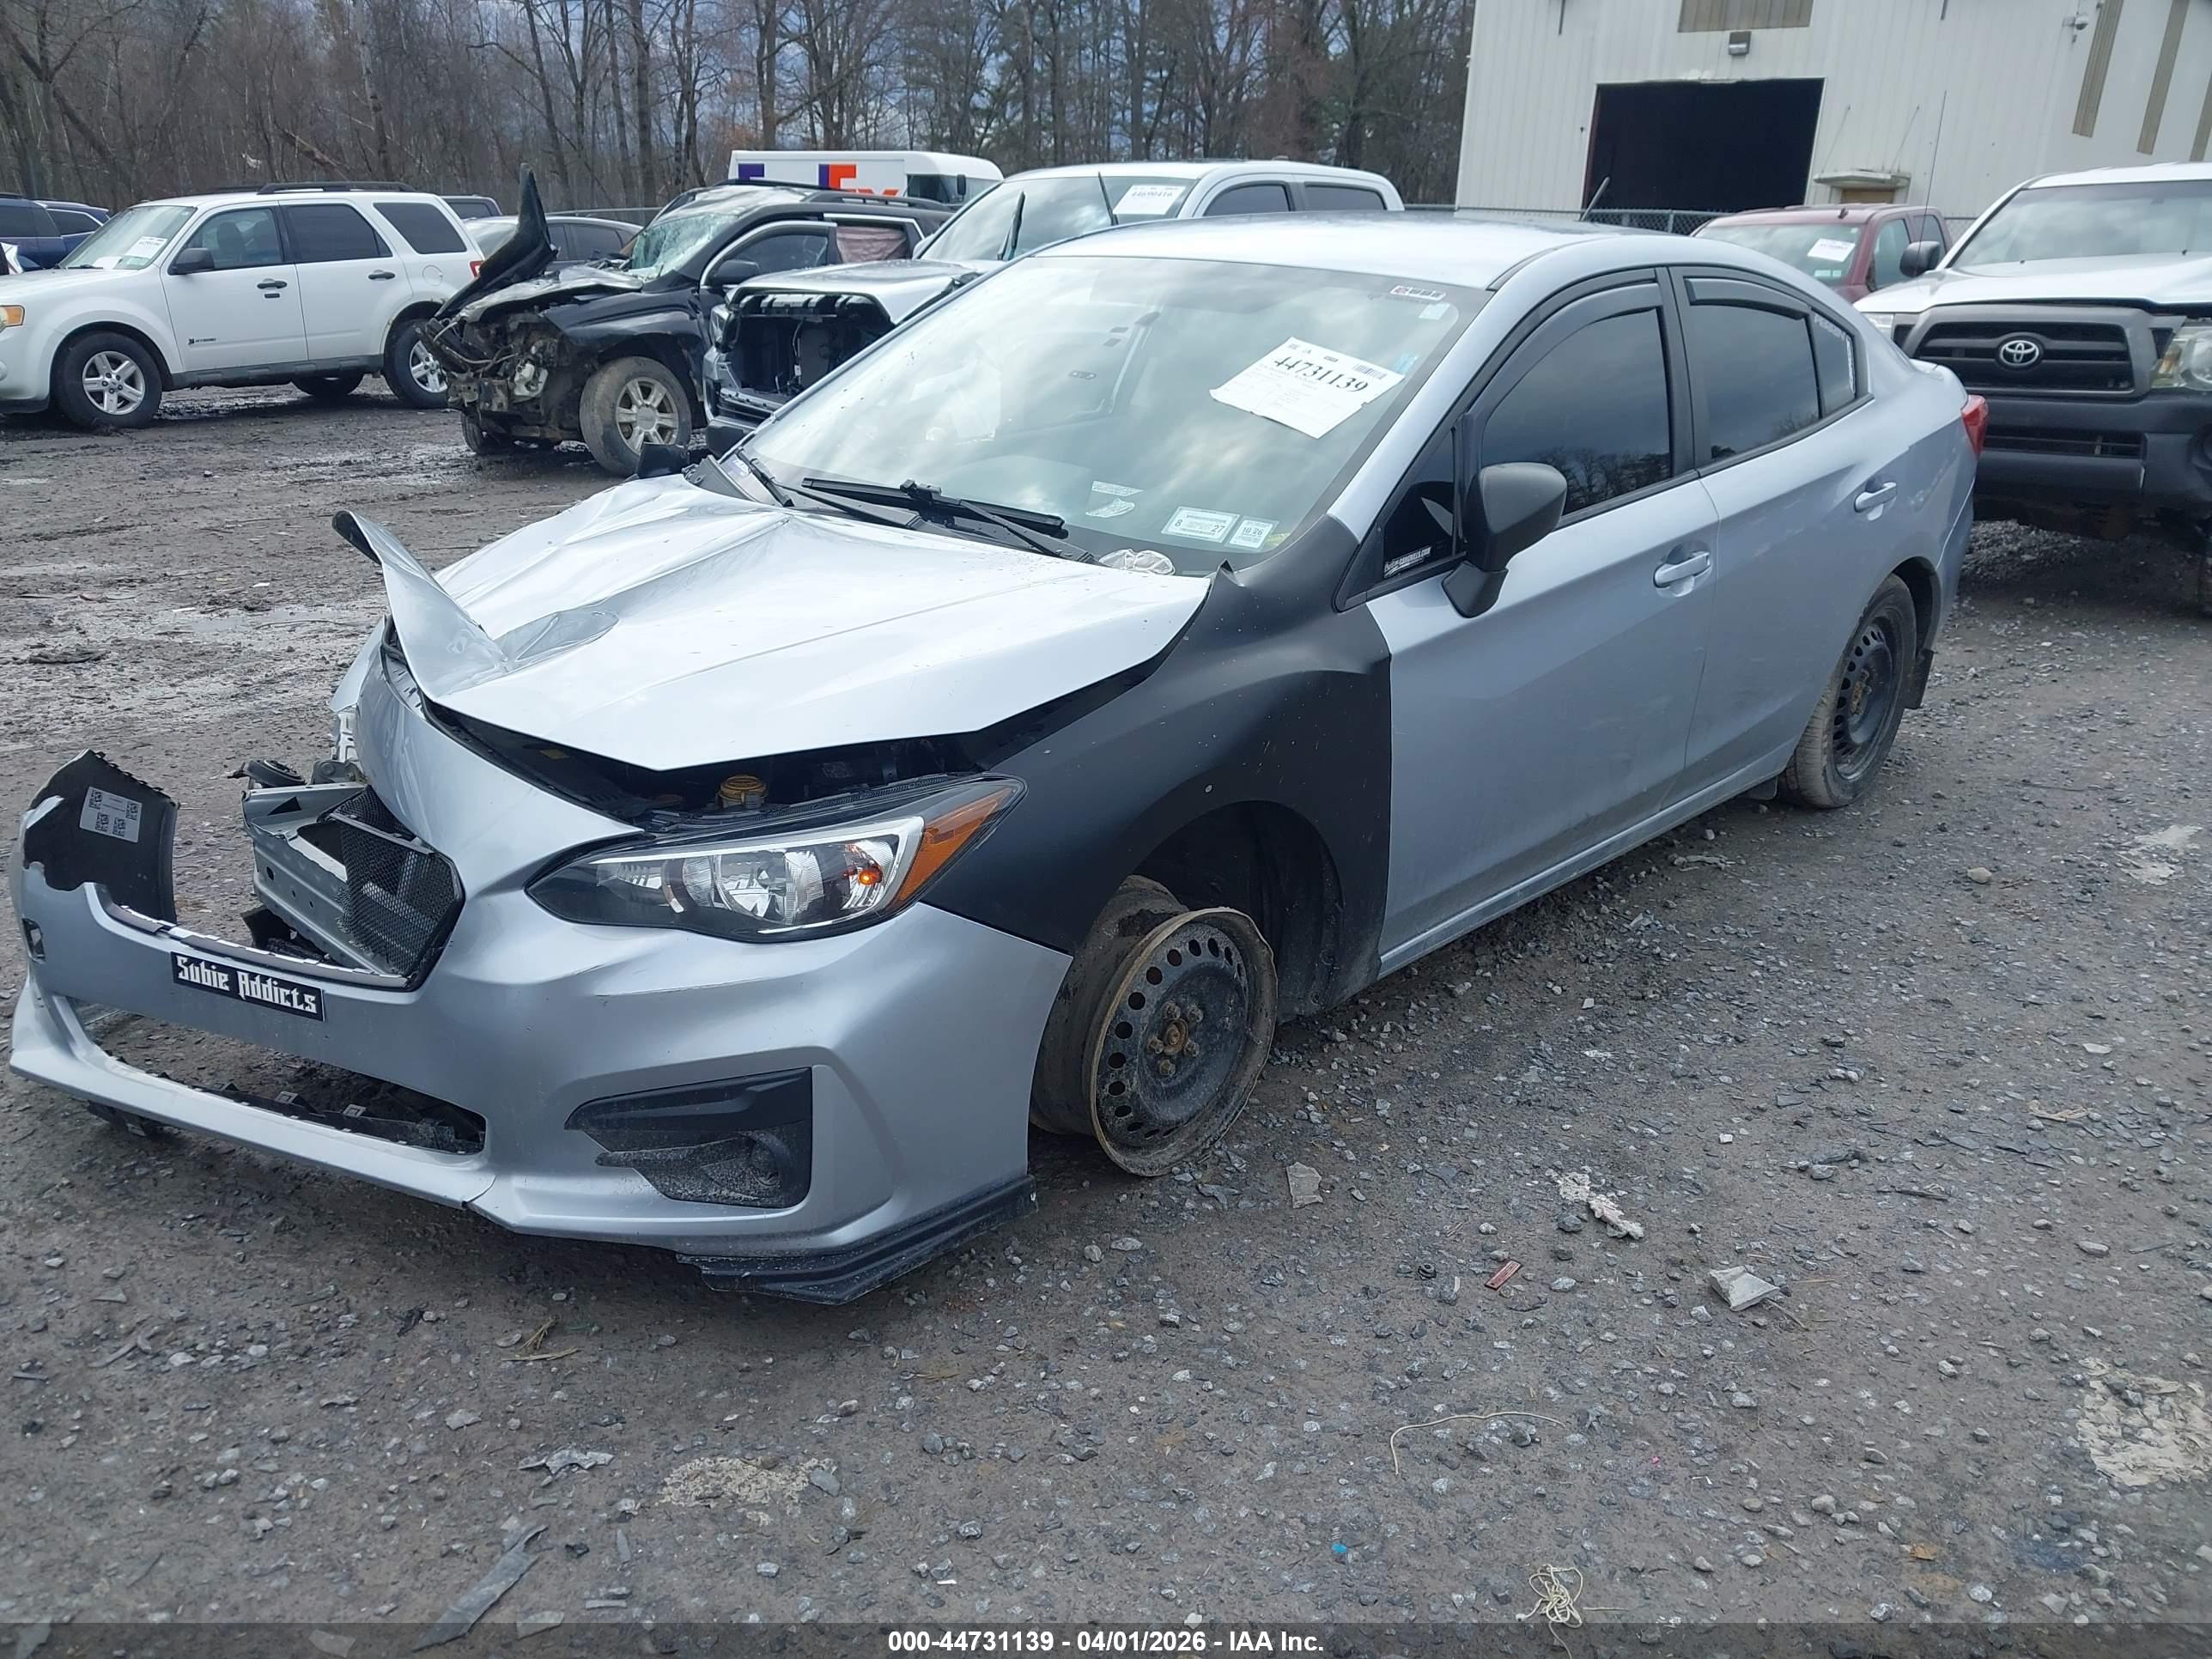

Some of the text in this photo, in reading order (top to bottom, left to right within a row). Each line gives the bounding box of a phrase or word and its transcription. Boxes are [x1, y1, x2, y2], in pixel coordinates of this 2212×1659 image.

[1274, 356, 1369, 392] 44731139
[1175, 519, 1183, 527] 8
[1211, 525, 1225, 533] 27
[1253, 527, 1265, 536] 26
[176, 955, 318, 1014] Subie Addicts
